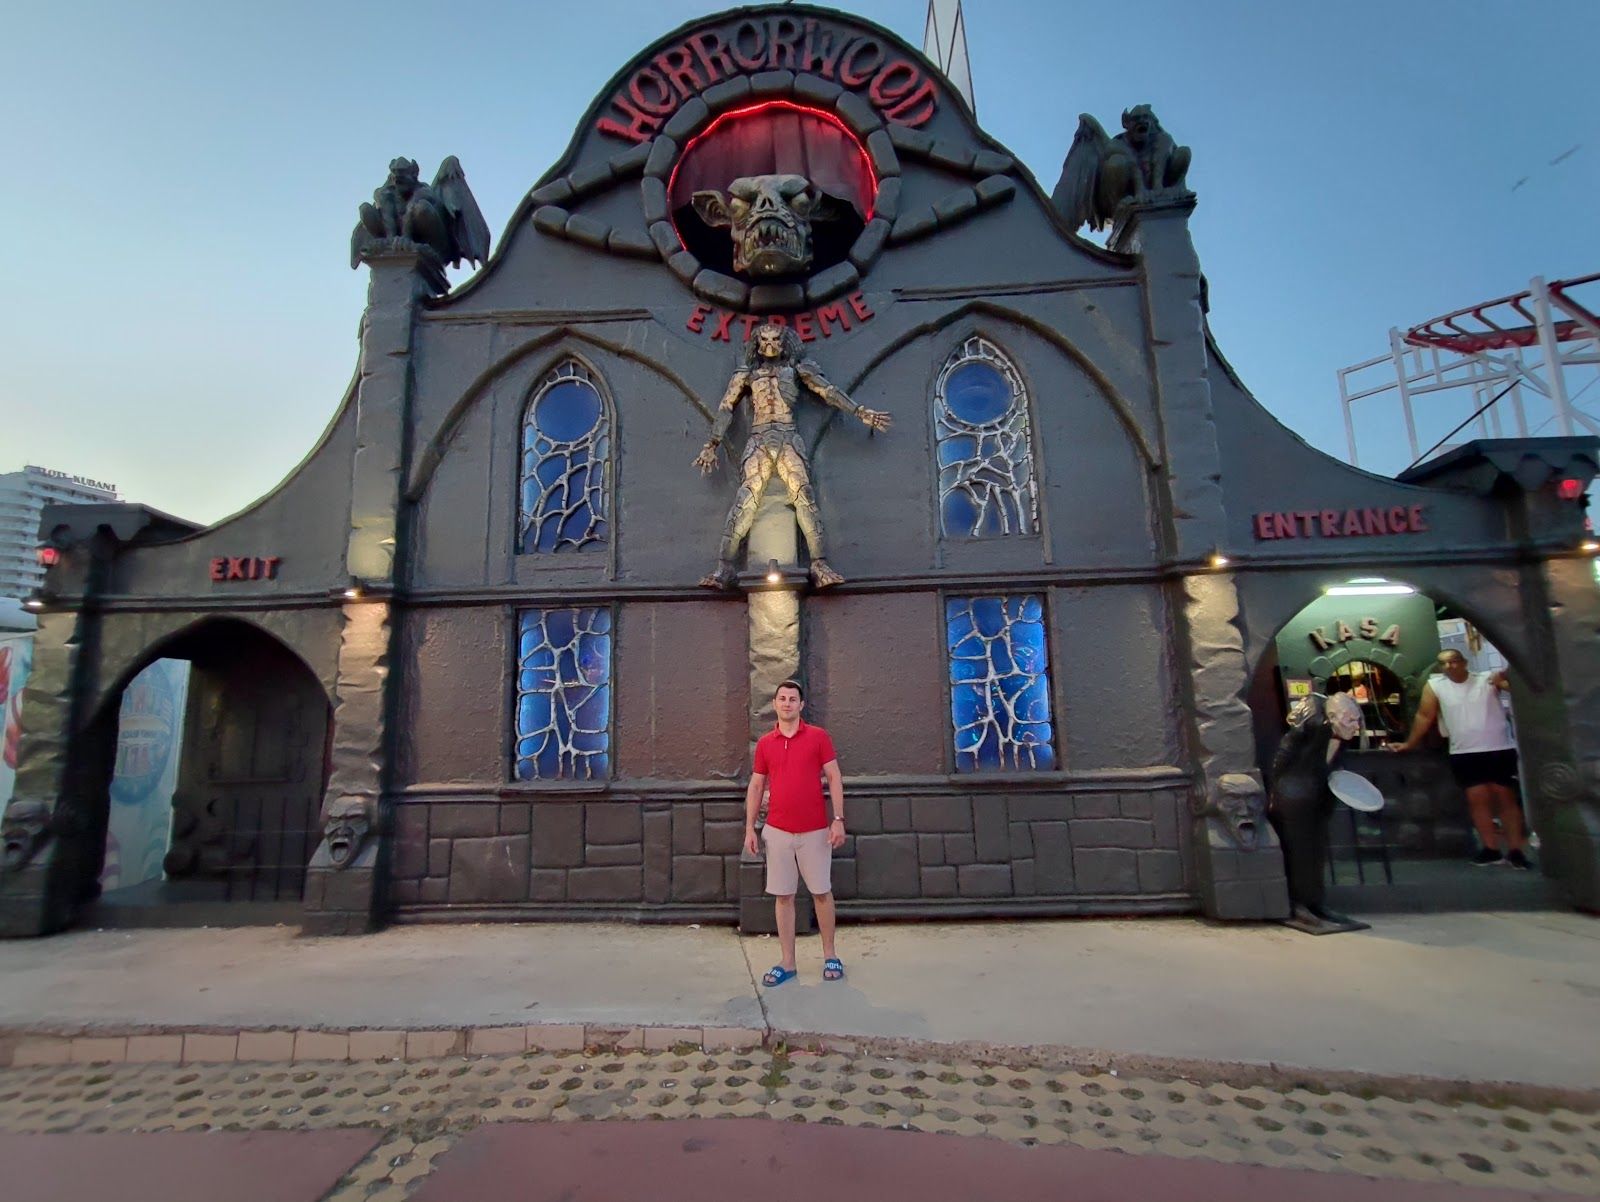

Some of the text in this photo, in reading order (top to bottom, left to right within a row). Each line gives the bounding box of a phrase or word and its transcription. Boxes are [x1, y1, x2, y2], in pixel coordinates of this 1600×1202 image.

[597, 18, 939, 143] HORRORWOOD
[1255, 503, 1429, 539] ENTRANCE
[209, 555, 283, 583] EXIT
[1309, 617, 1400, 650] KASA
